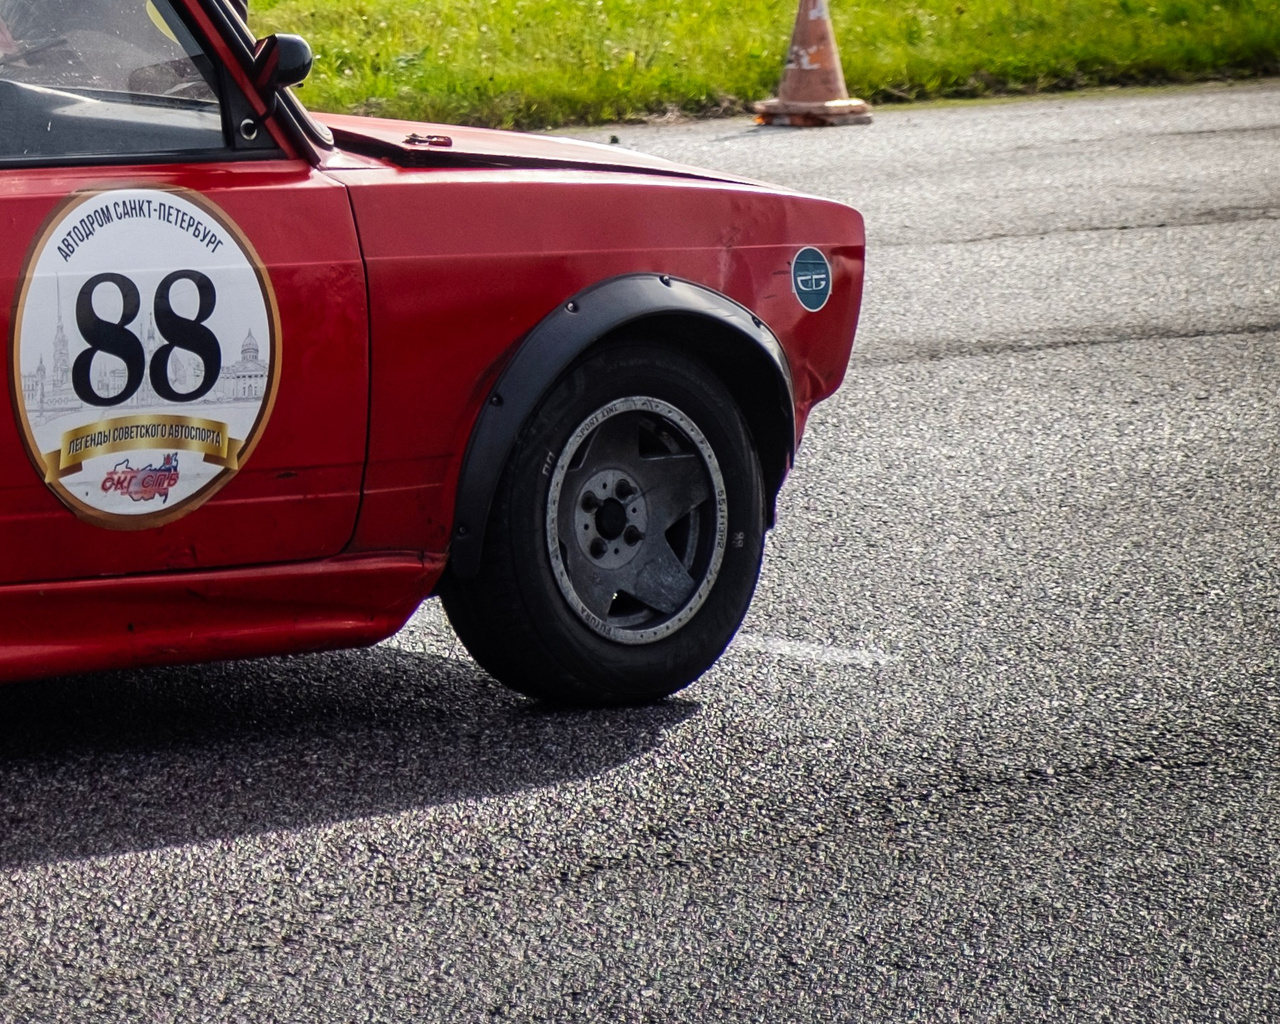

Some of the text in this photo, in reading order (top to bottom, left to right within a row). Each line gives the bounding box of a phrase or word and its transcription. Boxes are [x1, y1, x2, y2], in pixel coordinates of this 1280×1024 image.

[57, 199, 224, 262] АВТОДРОМ САНКТ-ПЕТЕРБУРГ
[72, 269, 222, 407] 88
[68, 423, 223, 455] ЛЕГЕНДЫ СОВЕТСКОГО АВТОСПОРТА
[579, 606, 613, 636] FUTURA
